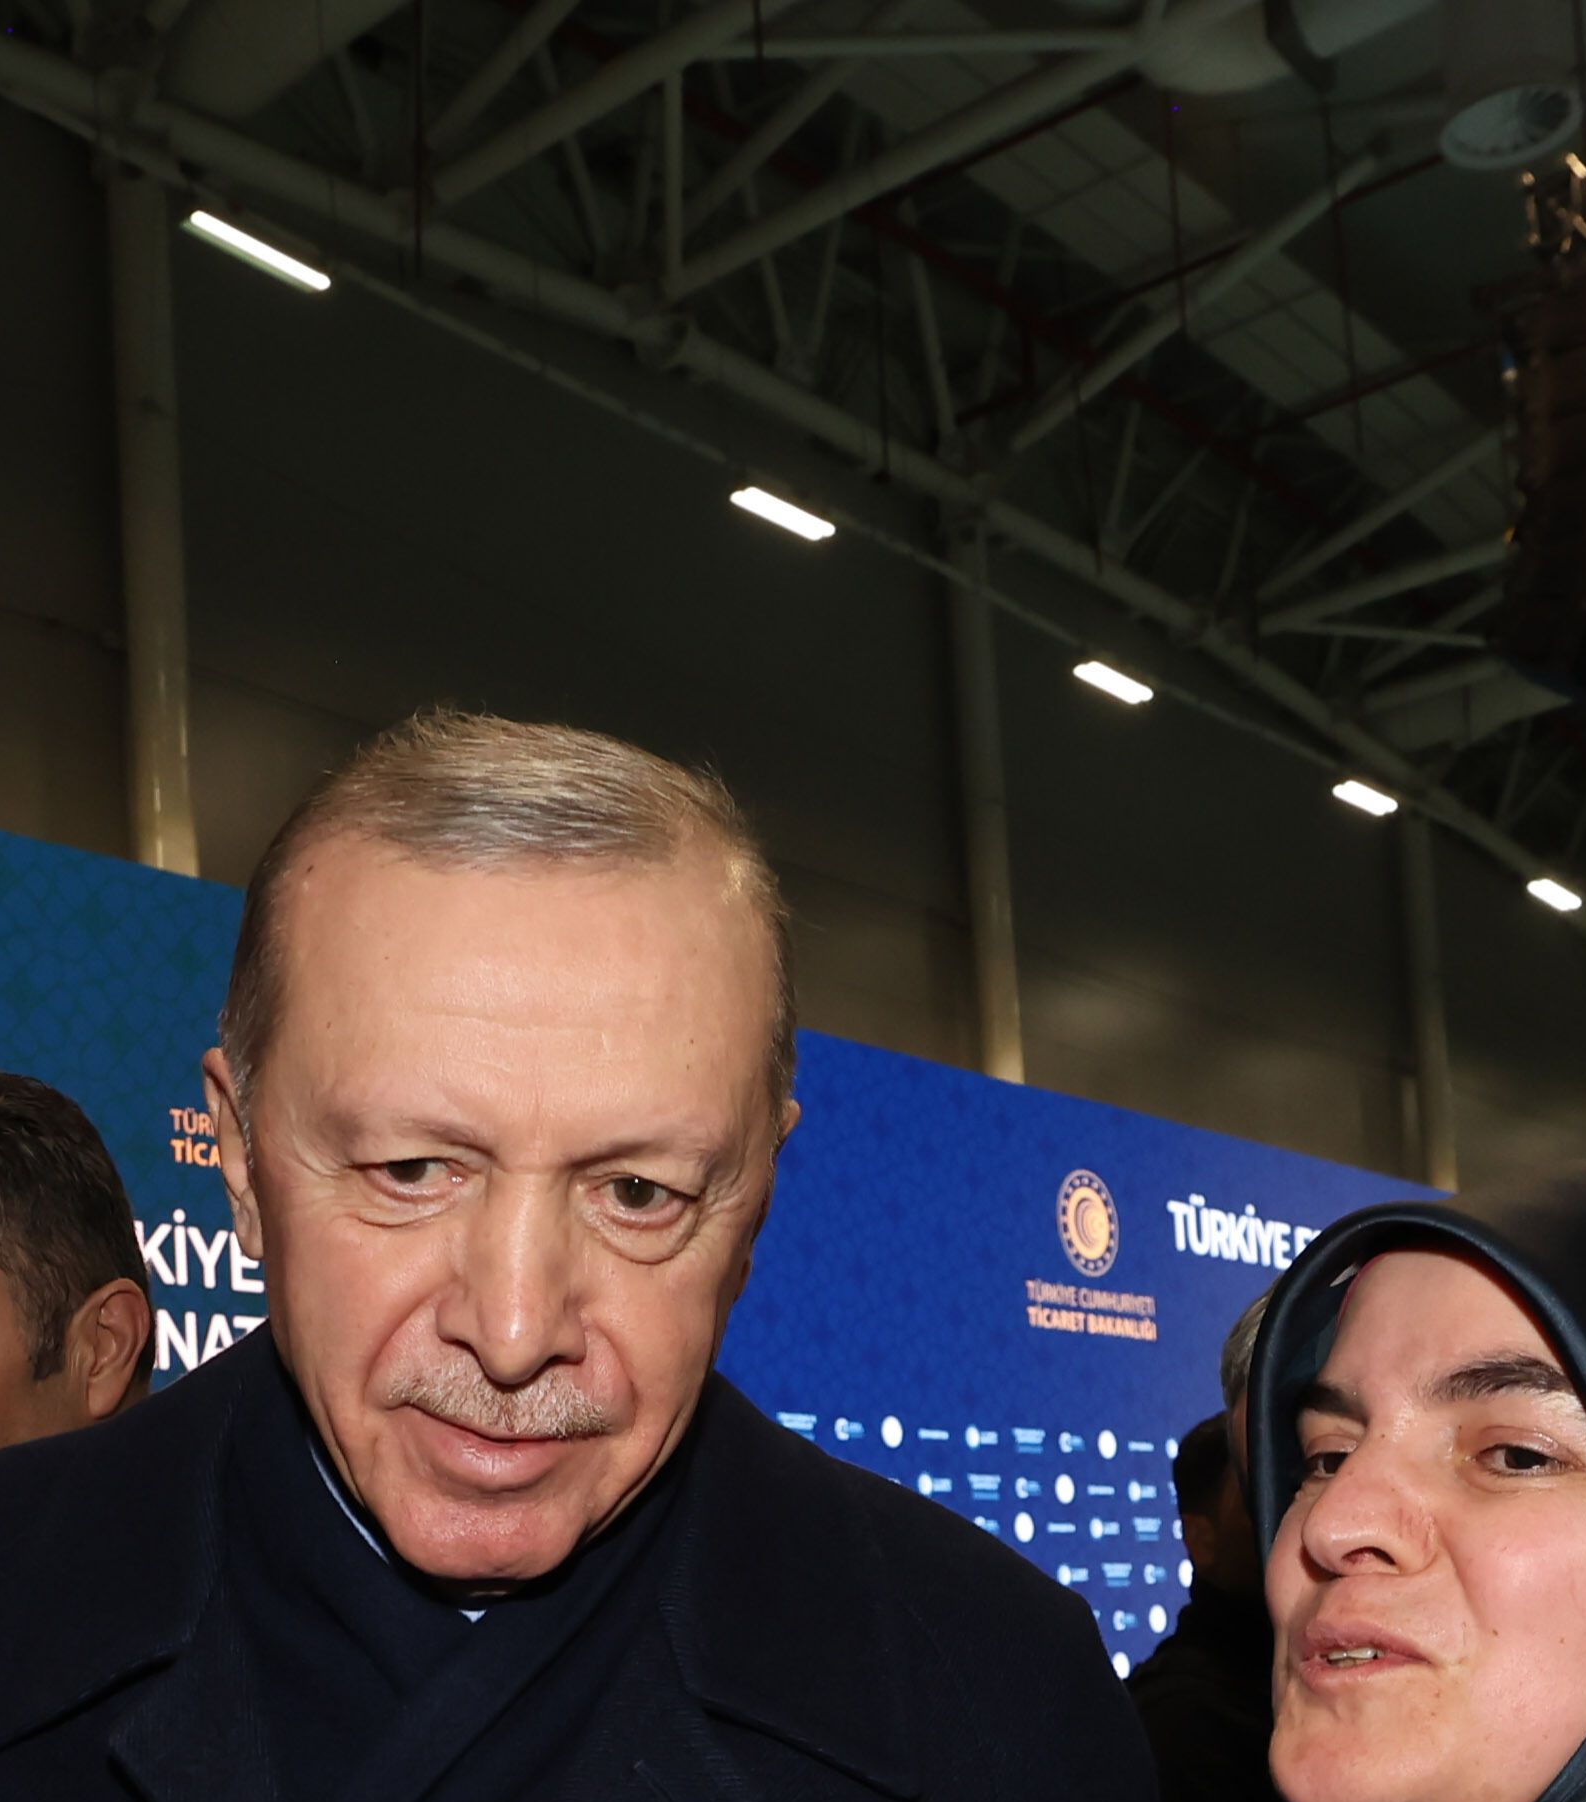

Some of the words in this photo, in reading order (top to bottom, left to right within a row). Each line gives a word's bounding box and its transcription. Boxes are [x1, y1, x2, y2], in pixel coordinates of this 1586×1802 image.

[169, 1107, 214, 1137] TÜR
[170, 1136, 222, 1168] TİCA
[1166, 1193, 1294, 1271] TÜRKİYE
[134, 1209, 265, 1293] KİYE
[1026, 1303, 1085, 1334] TİCARET
